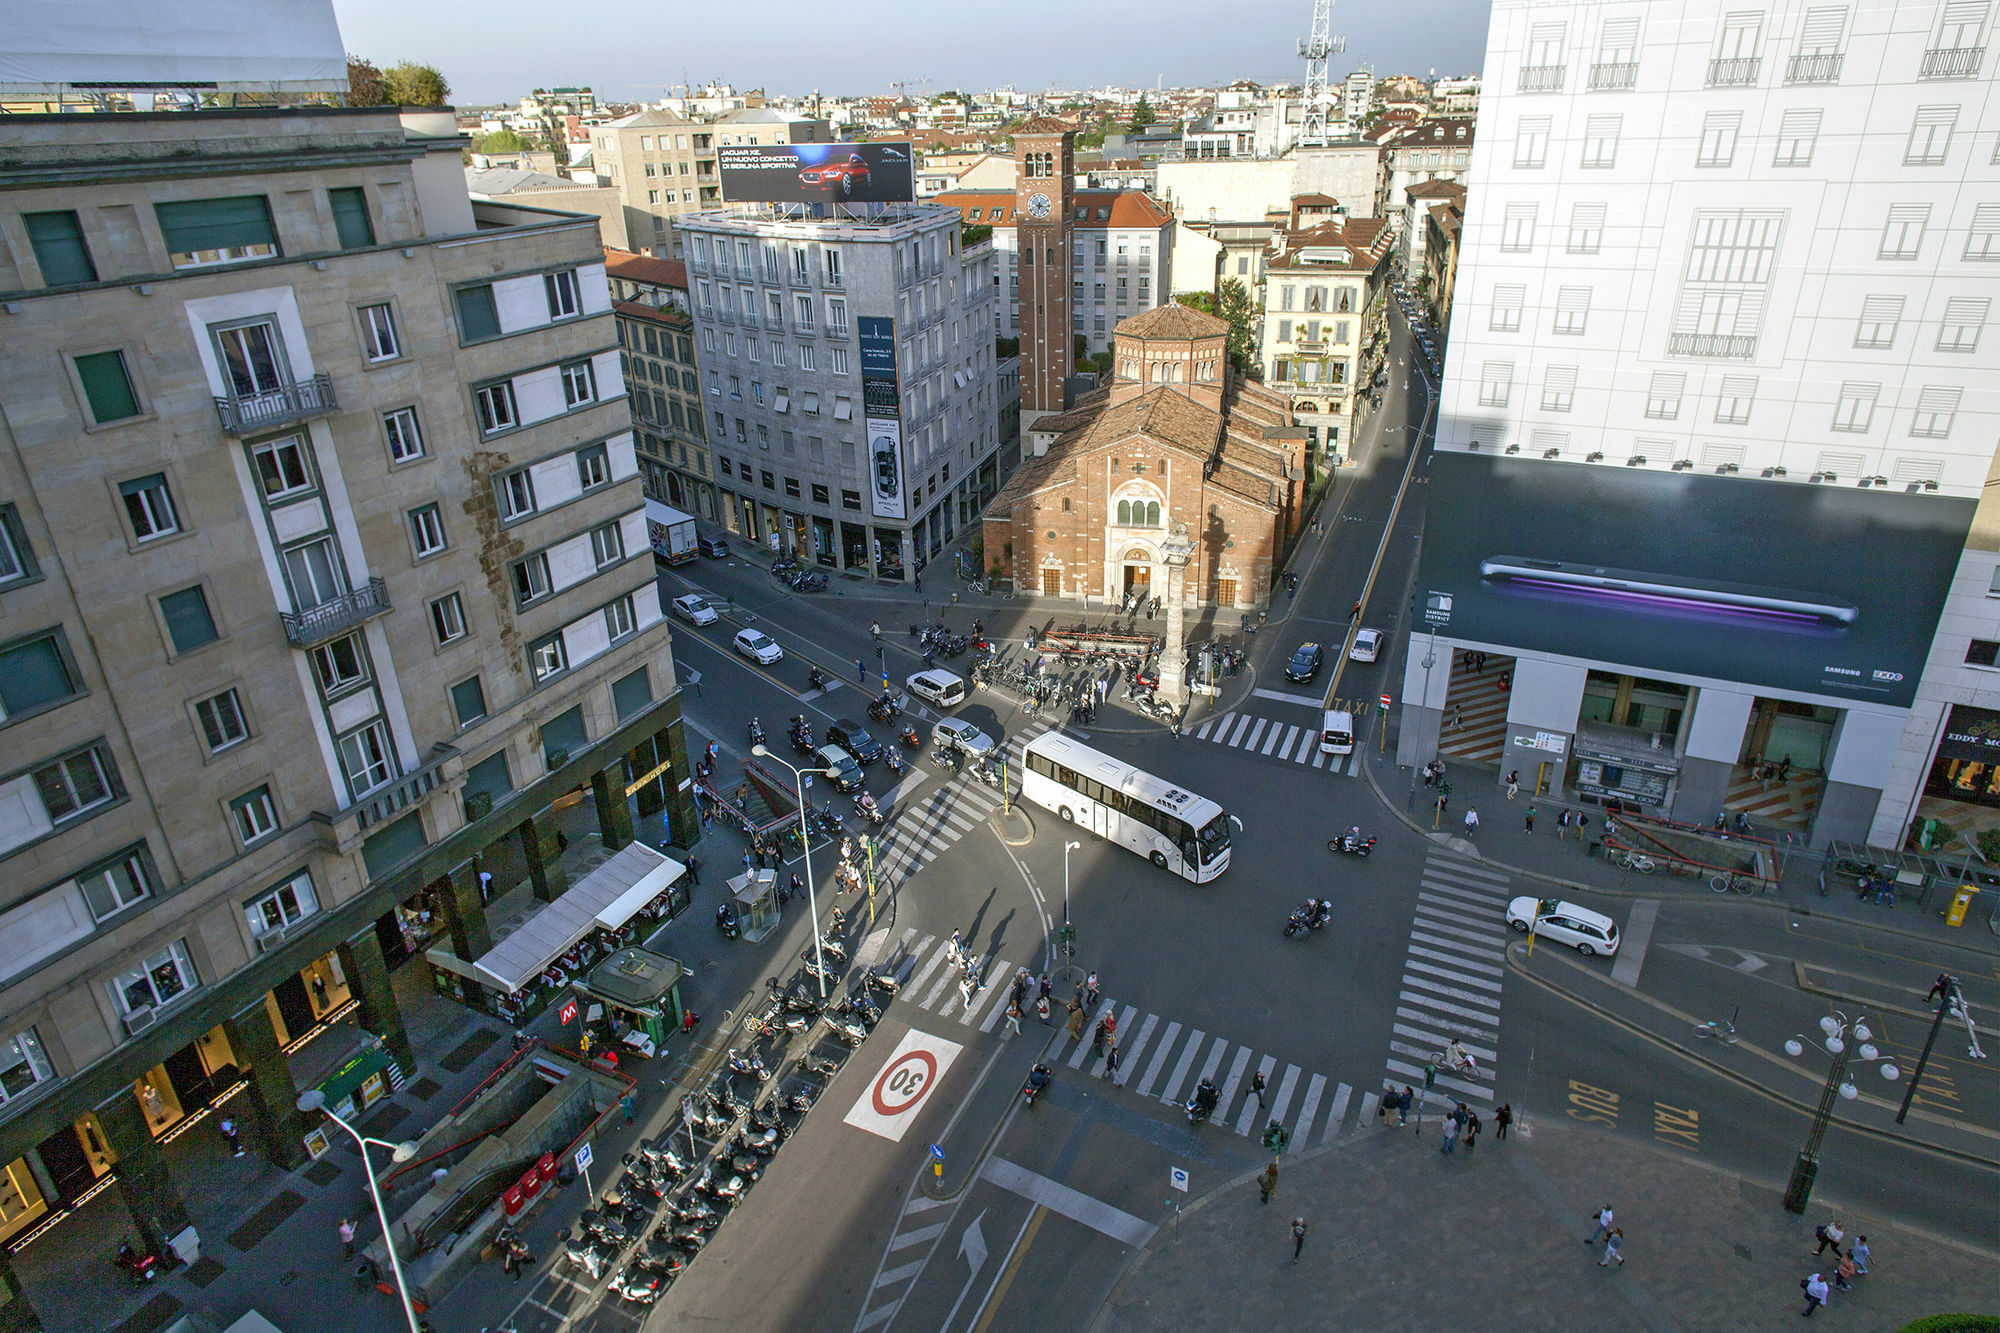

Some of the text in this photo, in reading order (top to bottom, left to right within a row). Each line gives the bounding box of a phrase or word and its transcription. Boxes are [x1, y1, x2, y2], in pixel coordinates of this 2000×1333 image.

[1425, 609, 1451, 617] SAMSUNG
[1425, 614, 1450, 622] DISTRICT
[1824, 666, 1861, 676] SAMSUNG
[1334, 698, 1369, 716] TAXI
[1947, 733, 1980, 743] EDDY
[626, 761, 672, 797] ZARA HOME
[331, 1000, 361, 1023] CONTI
[563, 1005, 577, 1022] M
[214, 1080, 249, 1107] CONTI
[889, 1068, 923, 1096] 30
[1897, 1054, 1964, 1113] TAXI
[1566, 1079, 1620, 1129] BUS
[1654, 1101, 1700, 1152] TAXI
[76, 1176, 118, 1208] CONTI
